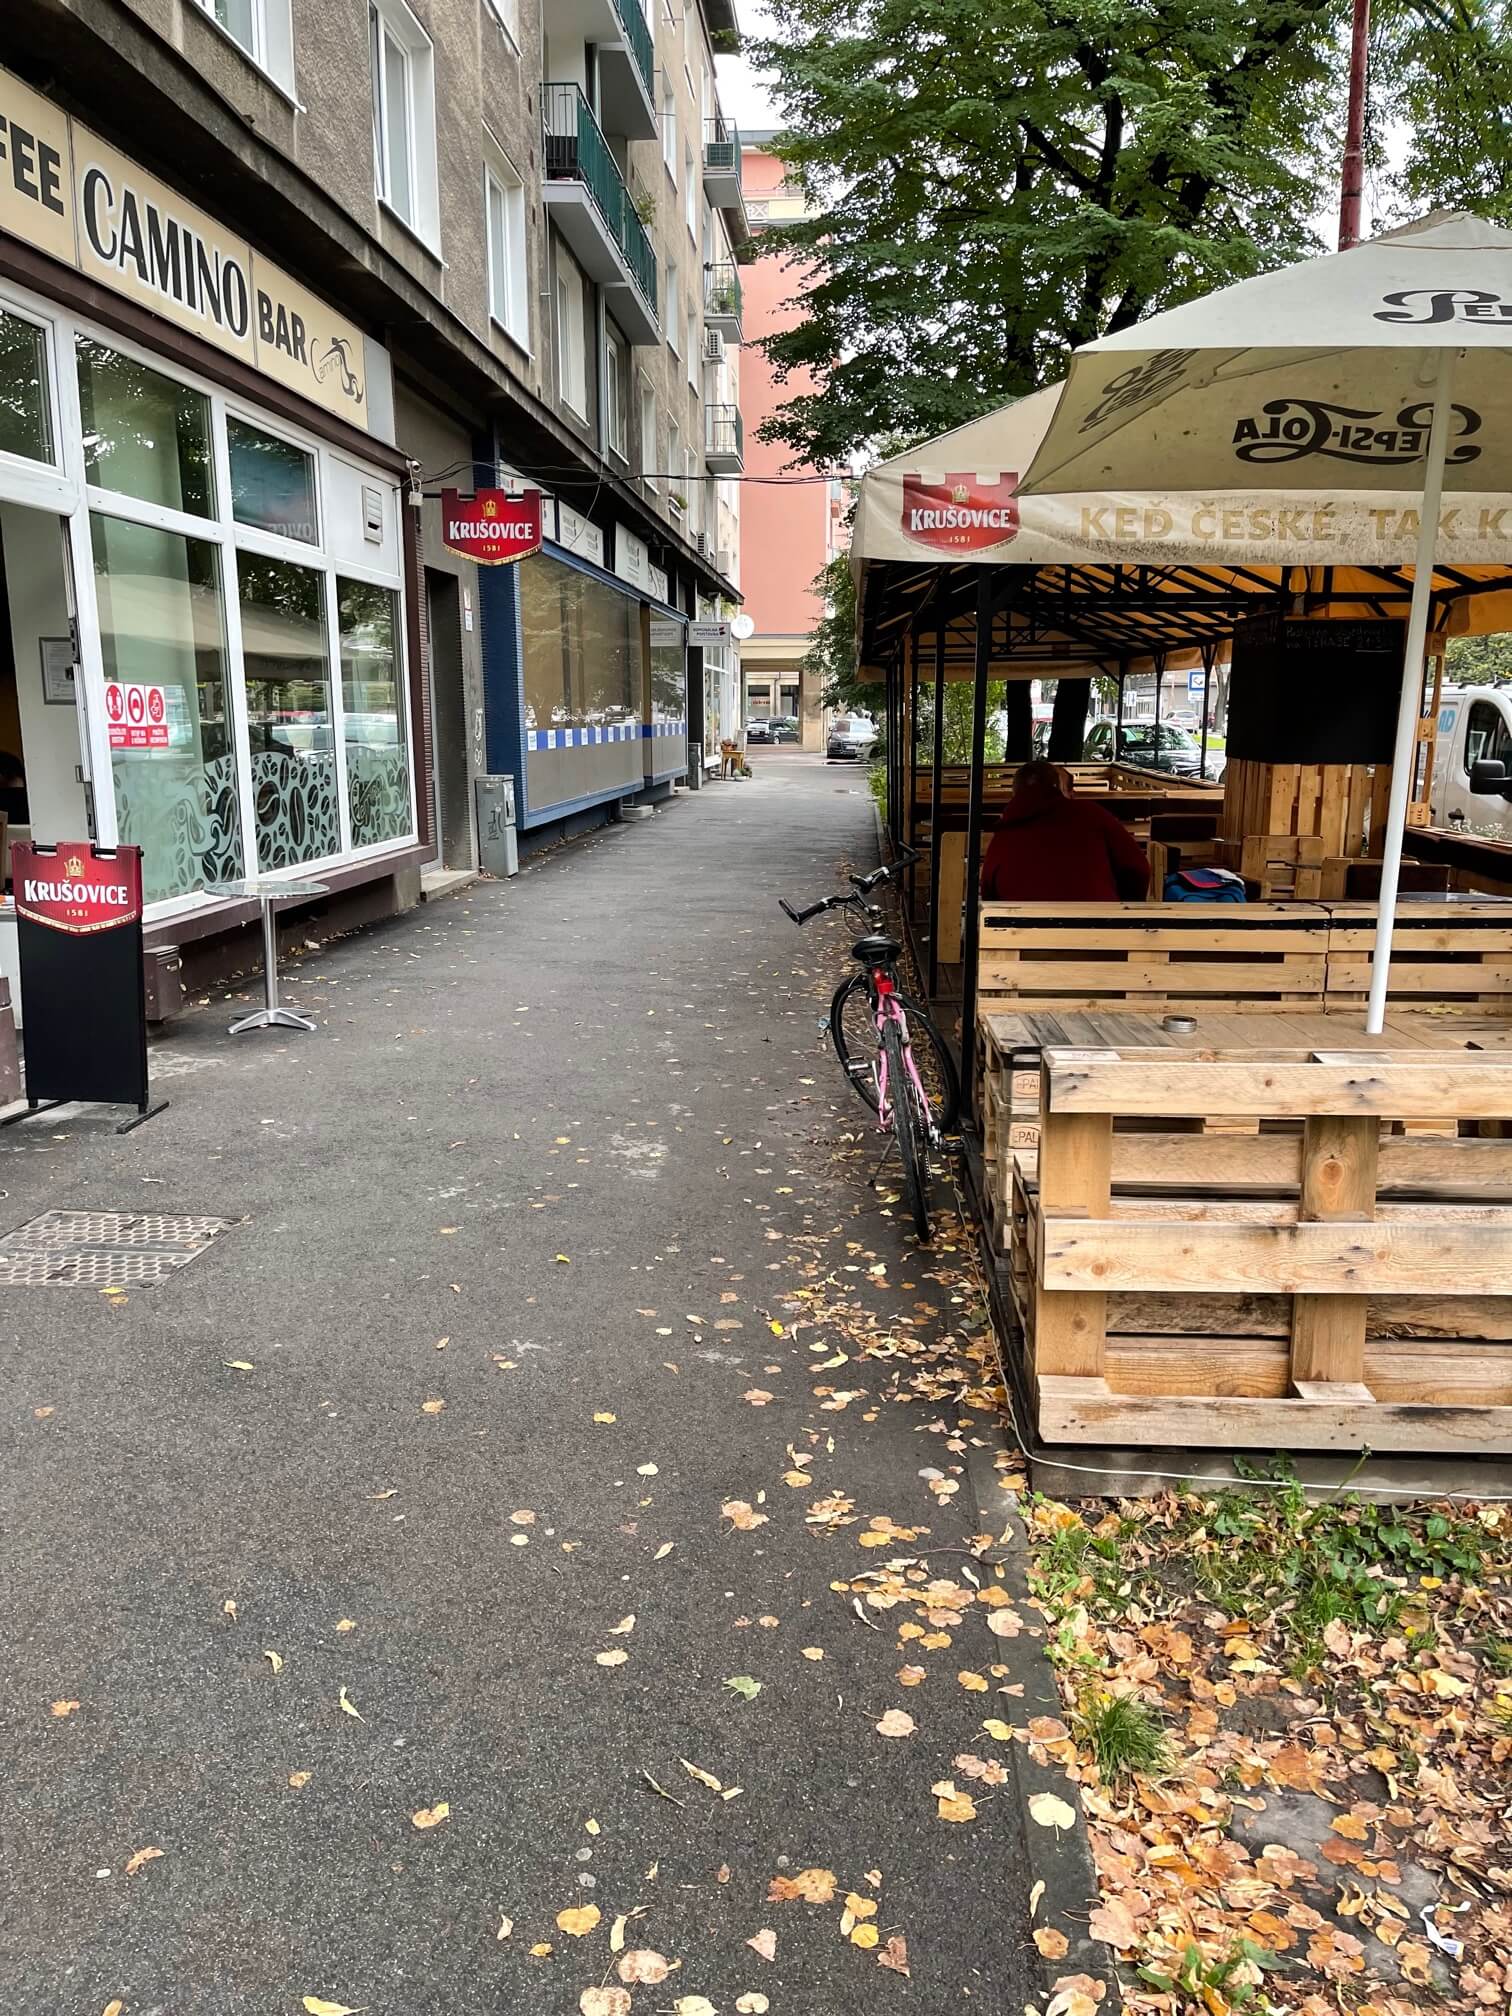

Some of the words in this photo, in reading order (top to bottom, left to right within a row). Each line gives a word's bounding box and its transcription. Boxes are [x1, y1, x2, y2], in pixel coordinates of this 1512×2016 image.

[83, 168, 248, 338] CAMINO
[257, 288, 308, 367] BAR
[449, 518, 534, 540] KRUŠOVICE
[911, 505, 1011, 531] KRUŠOVICE
[1081, 502, 1174, 540] KEĎ
[1191, 501, 1351, 545] ČESKÉ,
[949, 535, 970, 543] 1581
[24, 879, 129, 905] KRUŠOVICE
